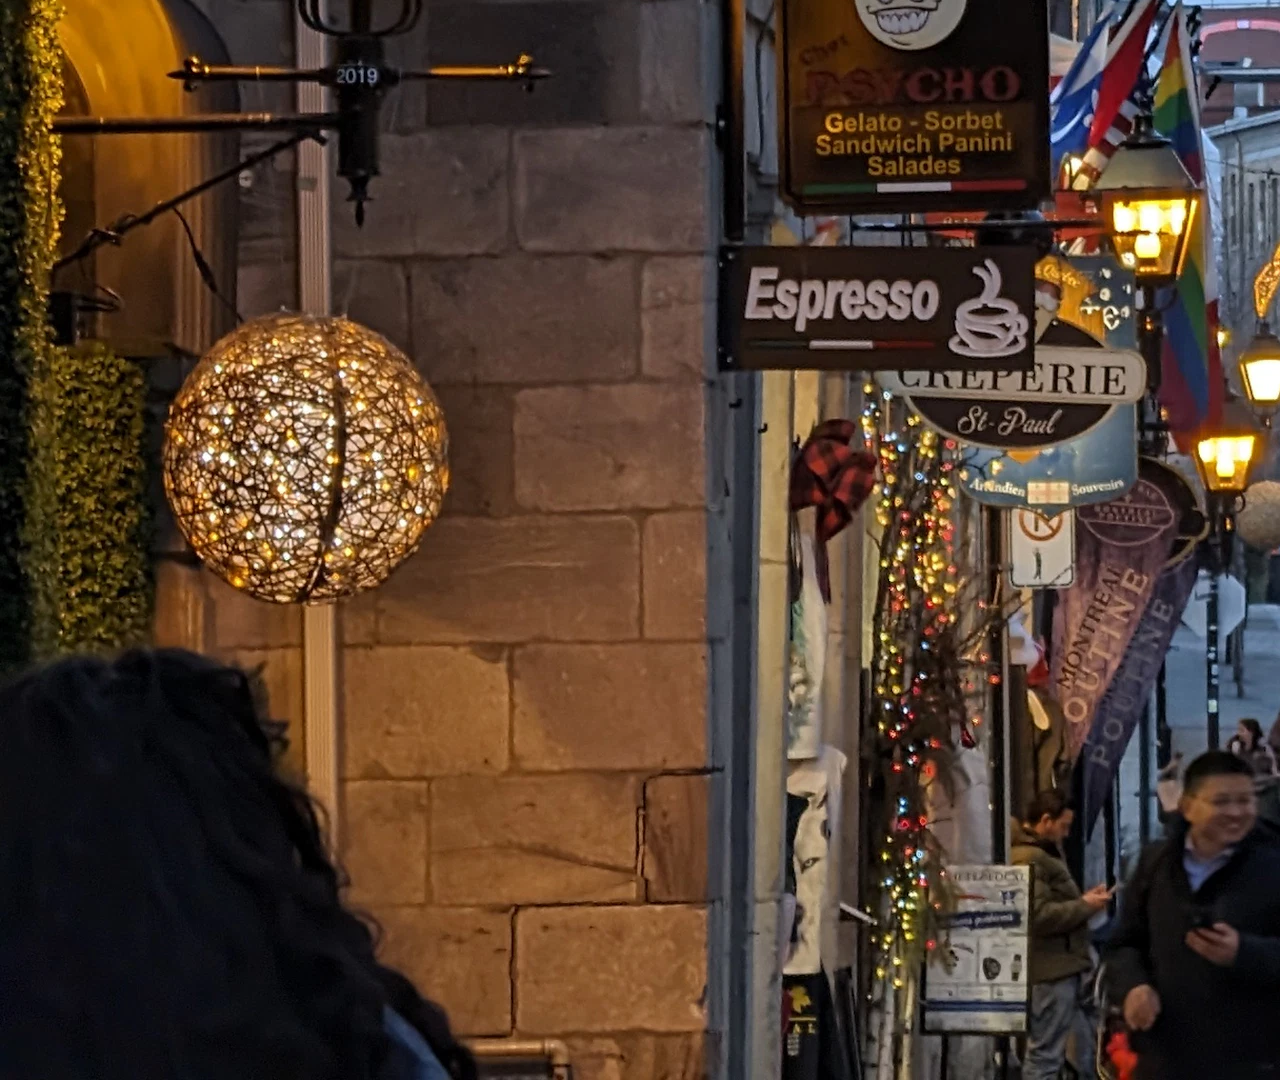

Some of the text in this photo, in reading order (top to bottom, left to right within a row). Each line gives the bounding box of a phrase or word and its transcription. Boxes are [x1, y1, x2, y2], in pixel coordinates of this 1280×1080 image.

[336, 67, 379, 88] 2019
[805, 65, 1022, 105] PSYCHO
[824, 112, 901, 133] Gelato
[924, 110, 1003, 131] Sorbet
[816, 132, 1013, 156] Sandwich Panini
[867, 156, 961, 176] Salades
[744, 266, 940, 333] Espresso
[957, 404, 1063, 435] St-Paul
[1063, 566, 1149, 723] OUTINE
